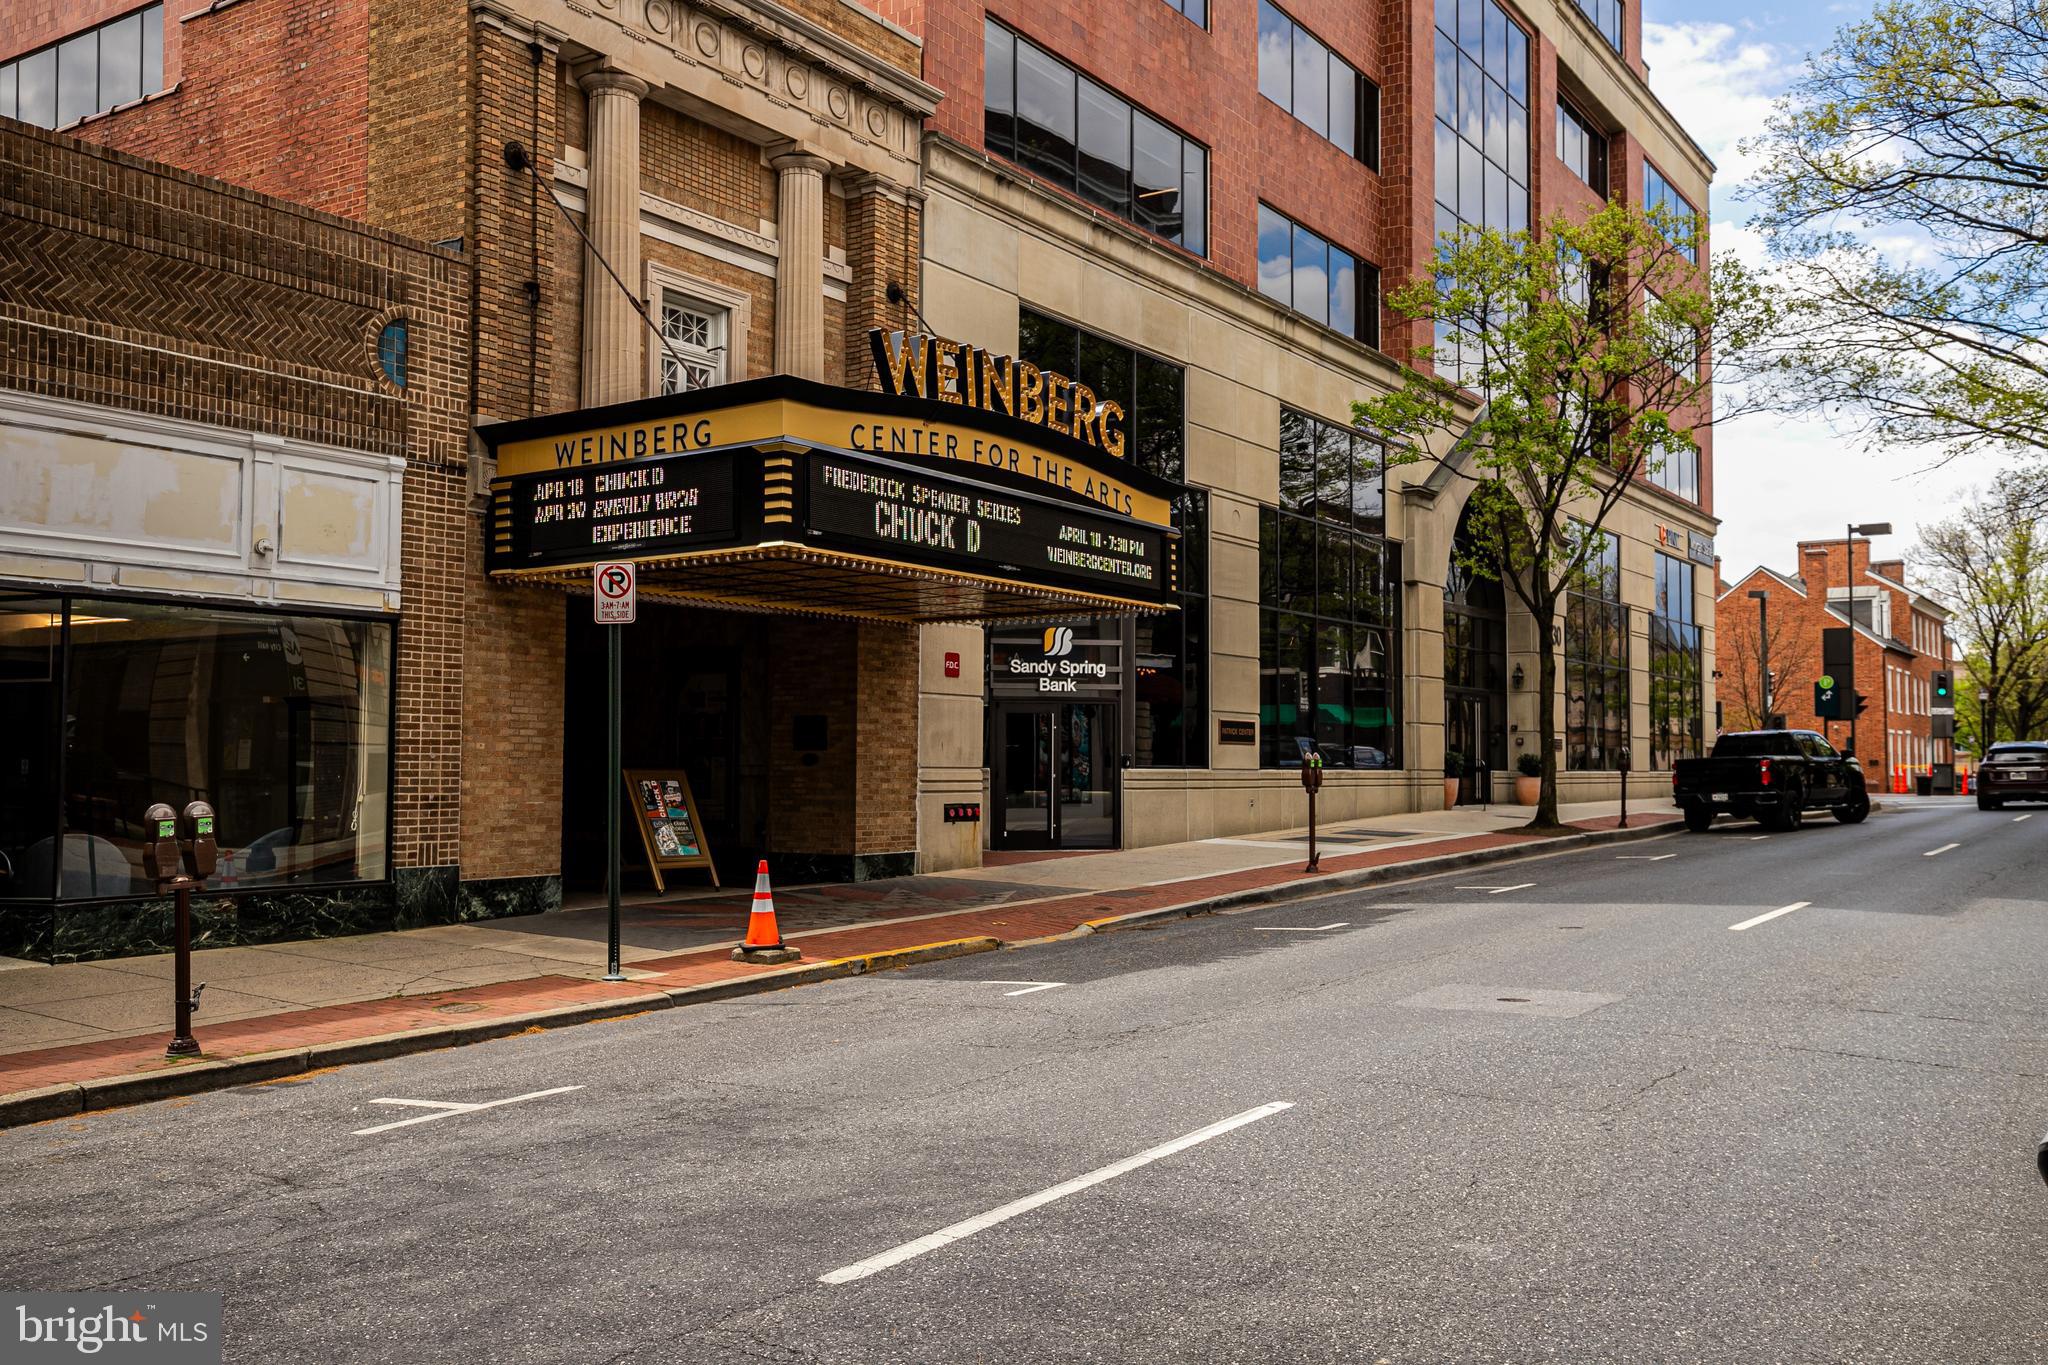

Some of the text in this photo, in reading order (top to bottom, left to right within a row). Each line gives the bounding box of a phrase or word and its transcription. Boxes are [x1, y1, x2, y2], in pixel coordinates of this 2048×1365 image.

[868, 327, 1126, 458] WEINBERG
[554, 419, 711, 467] WEINBERG
[850, 423, 1132, 515] CENTER FOR THE ARTS
[875, 499, 981, 553] CHUCK D
[1059, 525, 1088, 545] APRIL
[1129, 539, 1145, 557] PM
[1010, 659, 1106, 678] Sandy Spring
[1040, 678, 1077, 692] Bank
